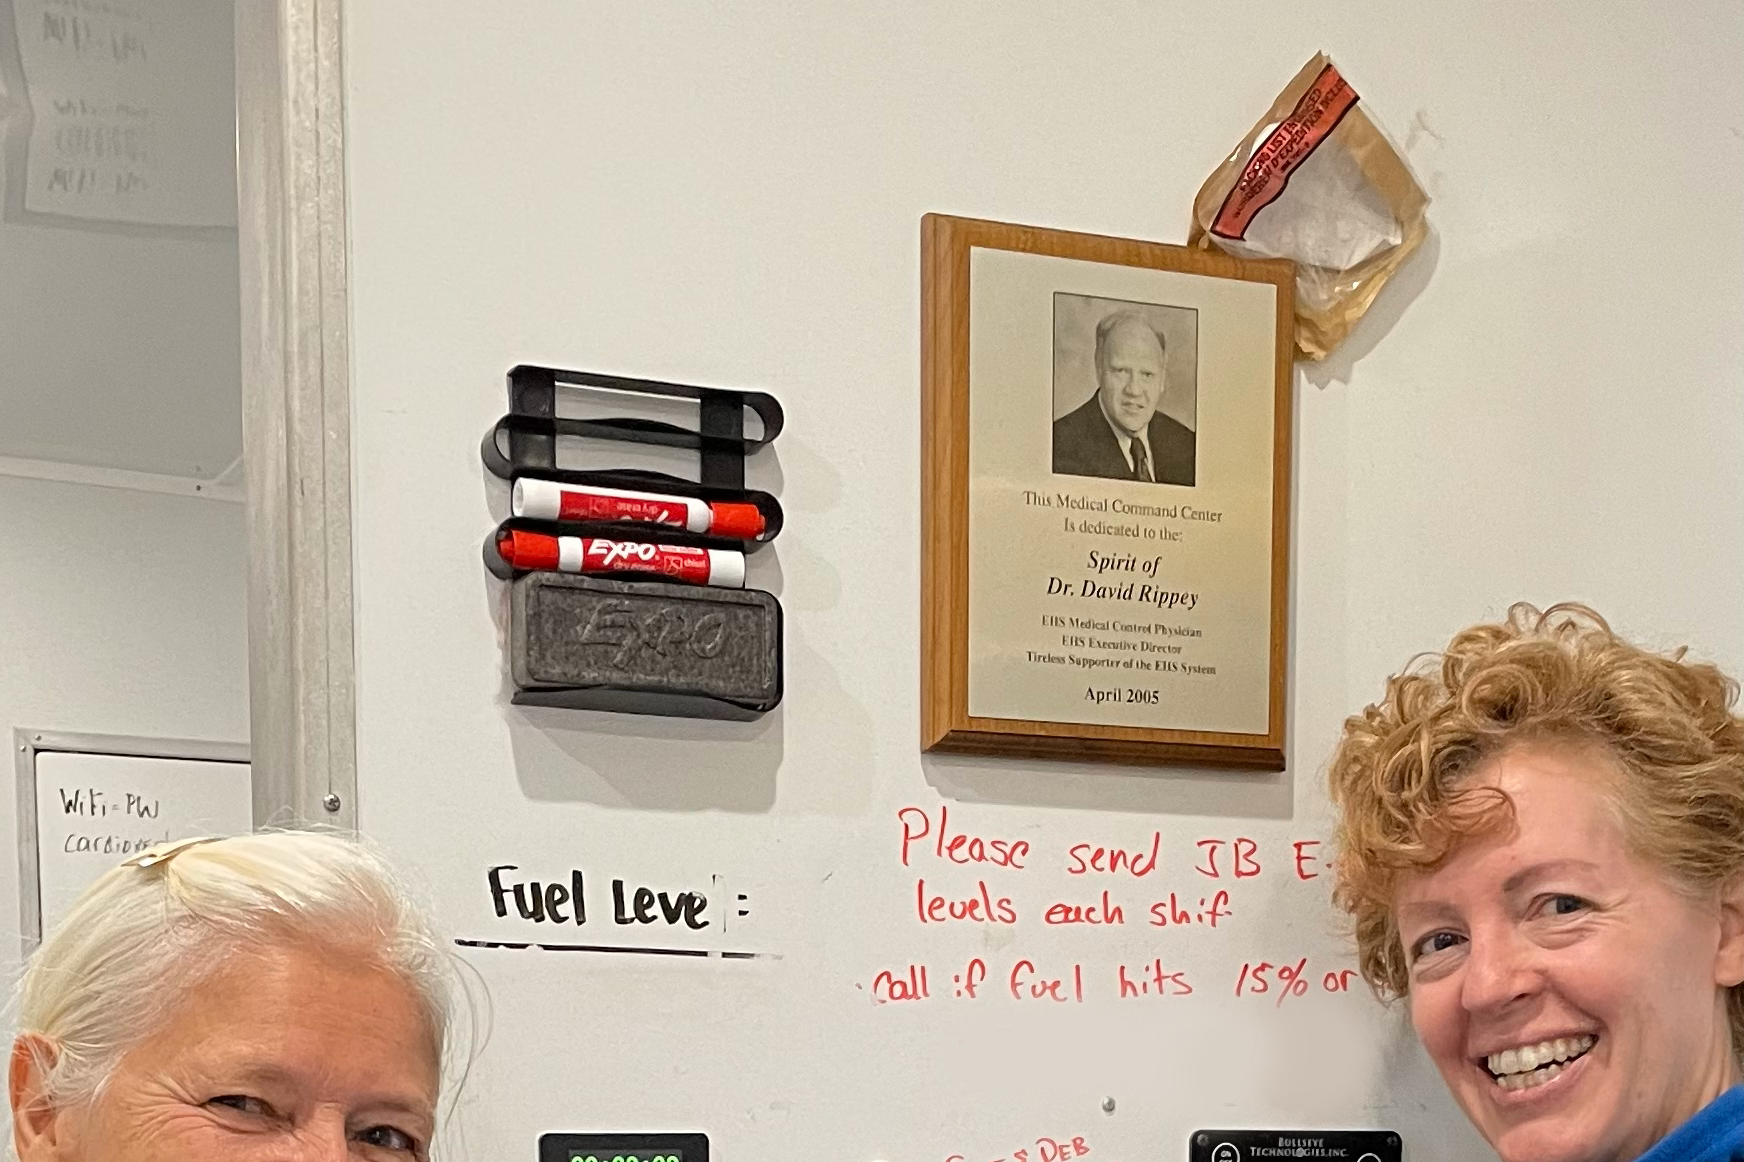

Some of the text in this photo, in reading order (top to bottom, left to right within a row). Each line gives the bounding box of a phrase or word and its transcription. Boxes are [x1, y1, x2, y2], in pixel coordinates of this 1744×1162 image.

[1267, 132, 1287, 154] LIST
[1022, 491, 1222, 522] This Medical Command Center
[1064, 517, 1075, 533] Is
[1079, 520, 1139, 538] dedicated
[1144, 527, 1156, 540] to
[588, 538, 656, 566] EXPO
[1087, 550, 1163, 579] Spirit of
[1047, 576, 1198, 610] Dr. David Rippey
[1069, 617, 1110, 631] Medical
[1112, 621, 1151, 634] Control
[1154, 624, 1202, 638] Physician
[1088, 637, 1138, 652] Executive
[1141, 641, 1182, 655] Director
[1026, 651, 1066, 664] Tireless
[1068, 654, 1120, 669] Supporter
[1122, 658, 1134, 669] of
[1136, 659, 1152, 670] the
[1180, 662, 1216, 675] System
[1084, 686, 1160, 704] April 2005
[898, 805, 1029, 869] Please
[1067, 832, 1160, 877] send
[1195, 838, 1261, 879] JB
[488, 865, 587, 926] Fuel
[917, 878, 1017, 924] levels
[1044, 890, 1125, 924] each
[953, 958, 986, 999] if
[1009, 960, 1083, 1003] fuel
[1119, 958, 1193, 998] hits
[1235, 958, 1309, 1008] 15%
[1323, 969, 1358, 992] or
